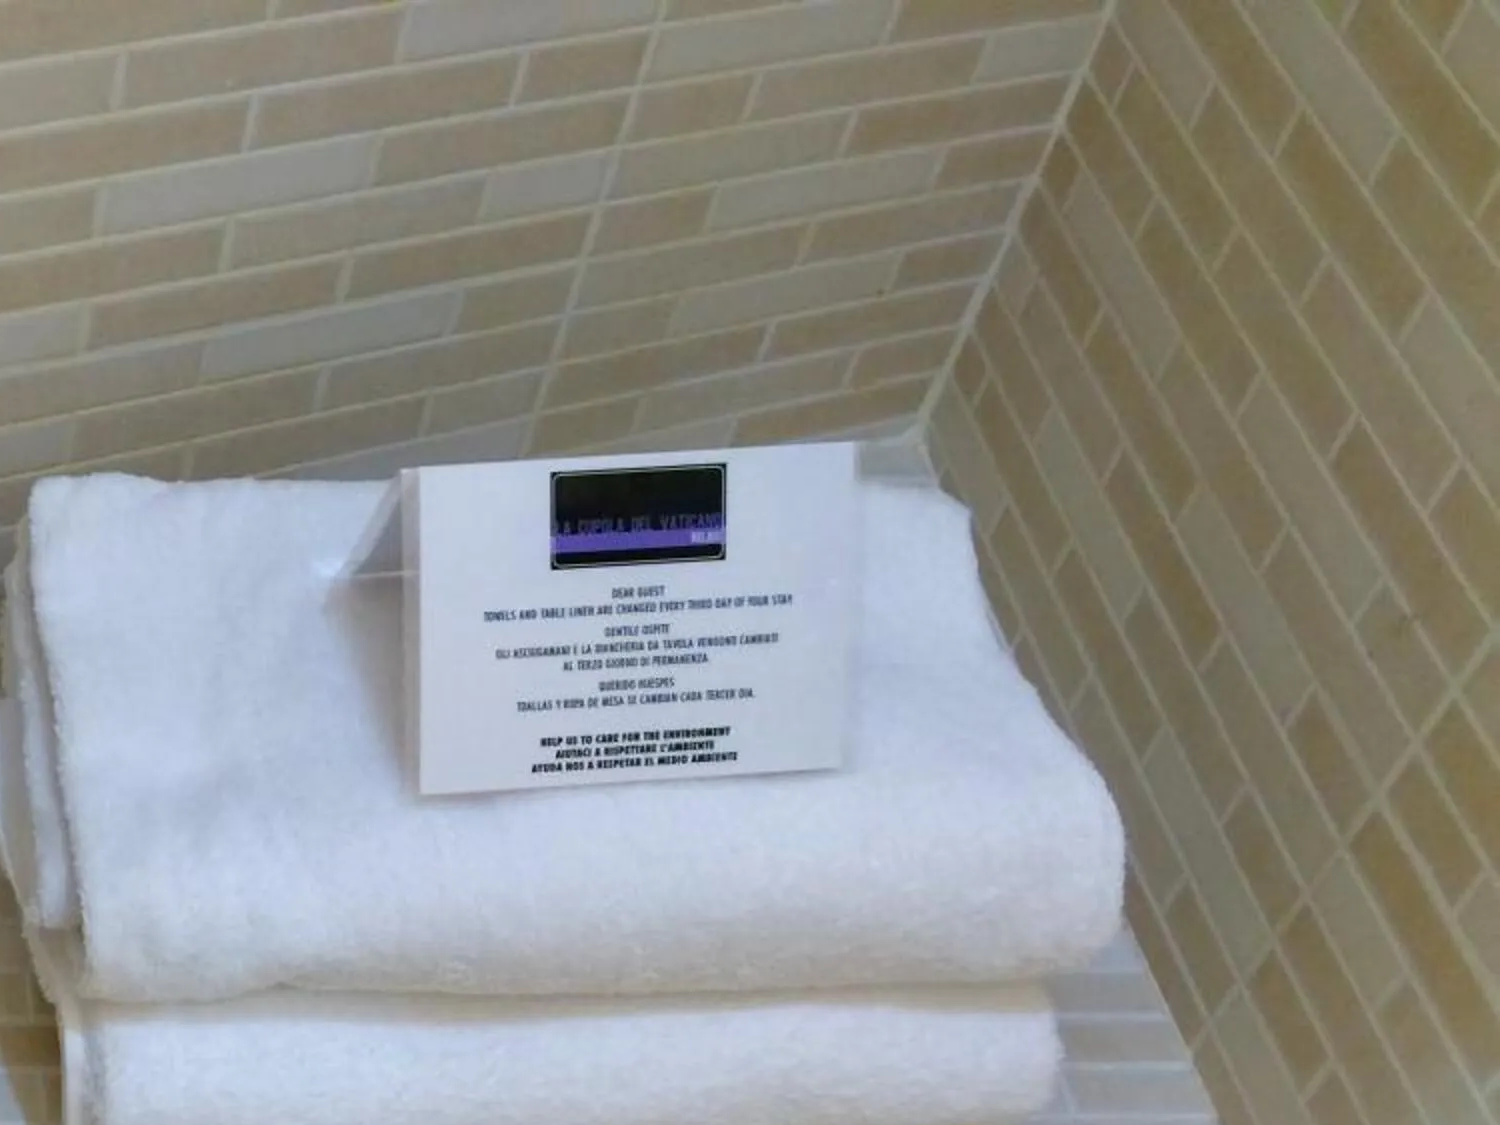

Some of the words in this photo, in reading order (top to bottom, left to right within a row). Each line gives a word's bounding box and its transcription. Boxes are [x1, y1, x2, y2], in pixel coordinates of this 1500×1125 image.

[612, 587, 634, 599] DEAR
[638, 585, 665, 598] GUEST
[484, 609, 516, 622] TOWELS
[519, 609, 537, 620] AND
[541, 607, 565, 619] TABLE
[596, 604, 612, 615] ARE
[616, 601, 656, 614] CHANGED
[660, 600, 685, 612] EVERY
[715, 597, 732, 609] DAY
[734, 596, 745, 607] OF
[748, 595, 768, 606] YOUR
[772, 593, 793, 605] STAY
[604, 625, 638, 637] GENTILE
[642, 623, 670, 635] OSPITE
[582, 643, 591, 655] LA
[648, 640, 659, 651] DA
[663, 638, 693, 649] TAVOLA
[578, 659, 603, 671] TERZO
[606, 657, 638, 669] GIORNO
[599, 680, 636, 692] QUERIDO
[517, 700, 552, 712] TOALLAS
[602, 696, 624, 707] MESA
[640, 693, 678, 704] CAMBIAN
[680, 691, 702, 702] CADA
[540, 737, 563, 747] HELP
[566, 736, 578, 745] US
[581, 735, 592, 745] TO
[596, 733, 619, 743] CARE
[622, 732, 640, 742] FOR
[644, 731, 660, 741] THE
[663, 726, 731, 739] ENVIRONMENT
[555, 748, 591, 759] AIUTACI
[594, 747, 600, 757] A
[603, 743, 656, 756] RISPETTARE
[660, 740, 715, 753] L'AMBIENTE
[532, 762, 562, 773] AYUDA
[565, 761, 584, 771] NOS
[588, 760, 594, 769] A
[597, 757, 641, 769] RESPETAR
[644, 757, 654, 766] EL
[657, 755, 689, 765] MEDIO
[691, 751, 738, 763] AMBIENTE
